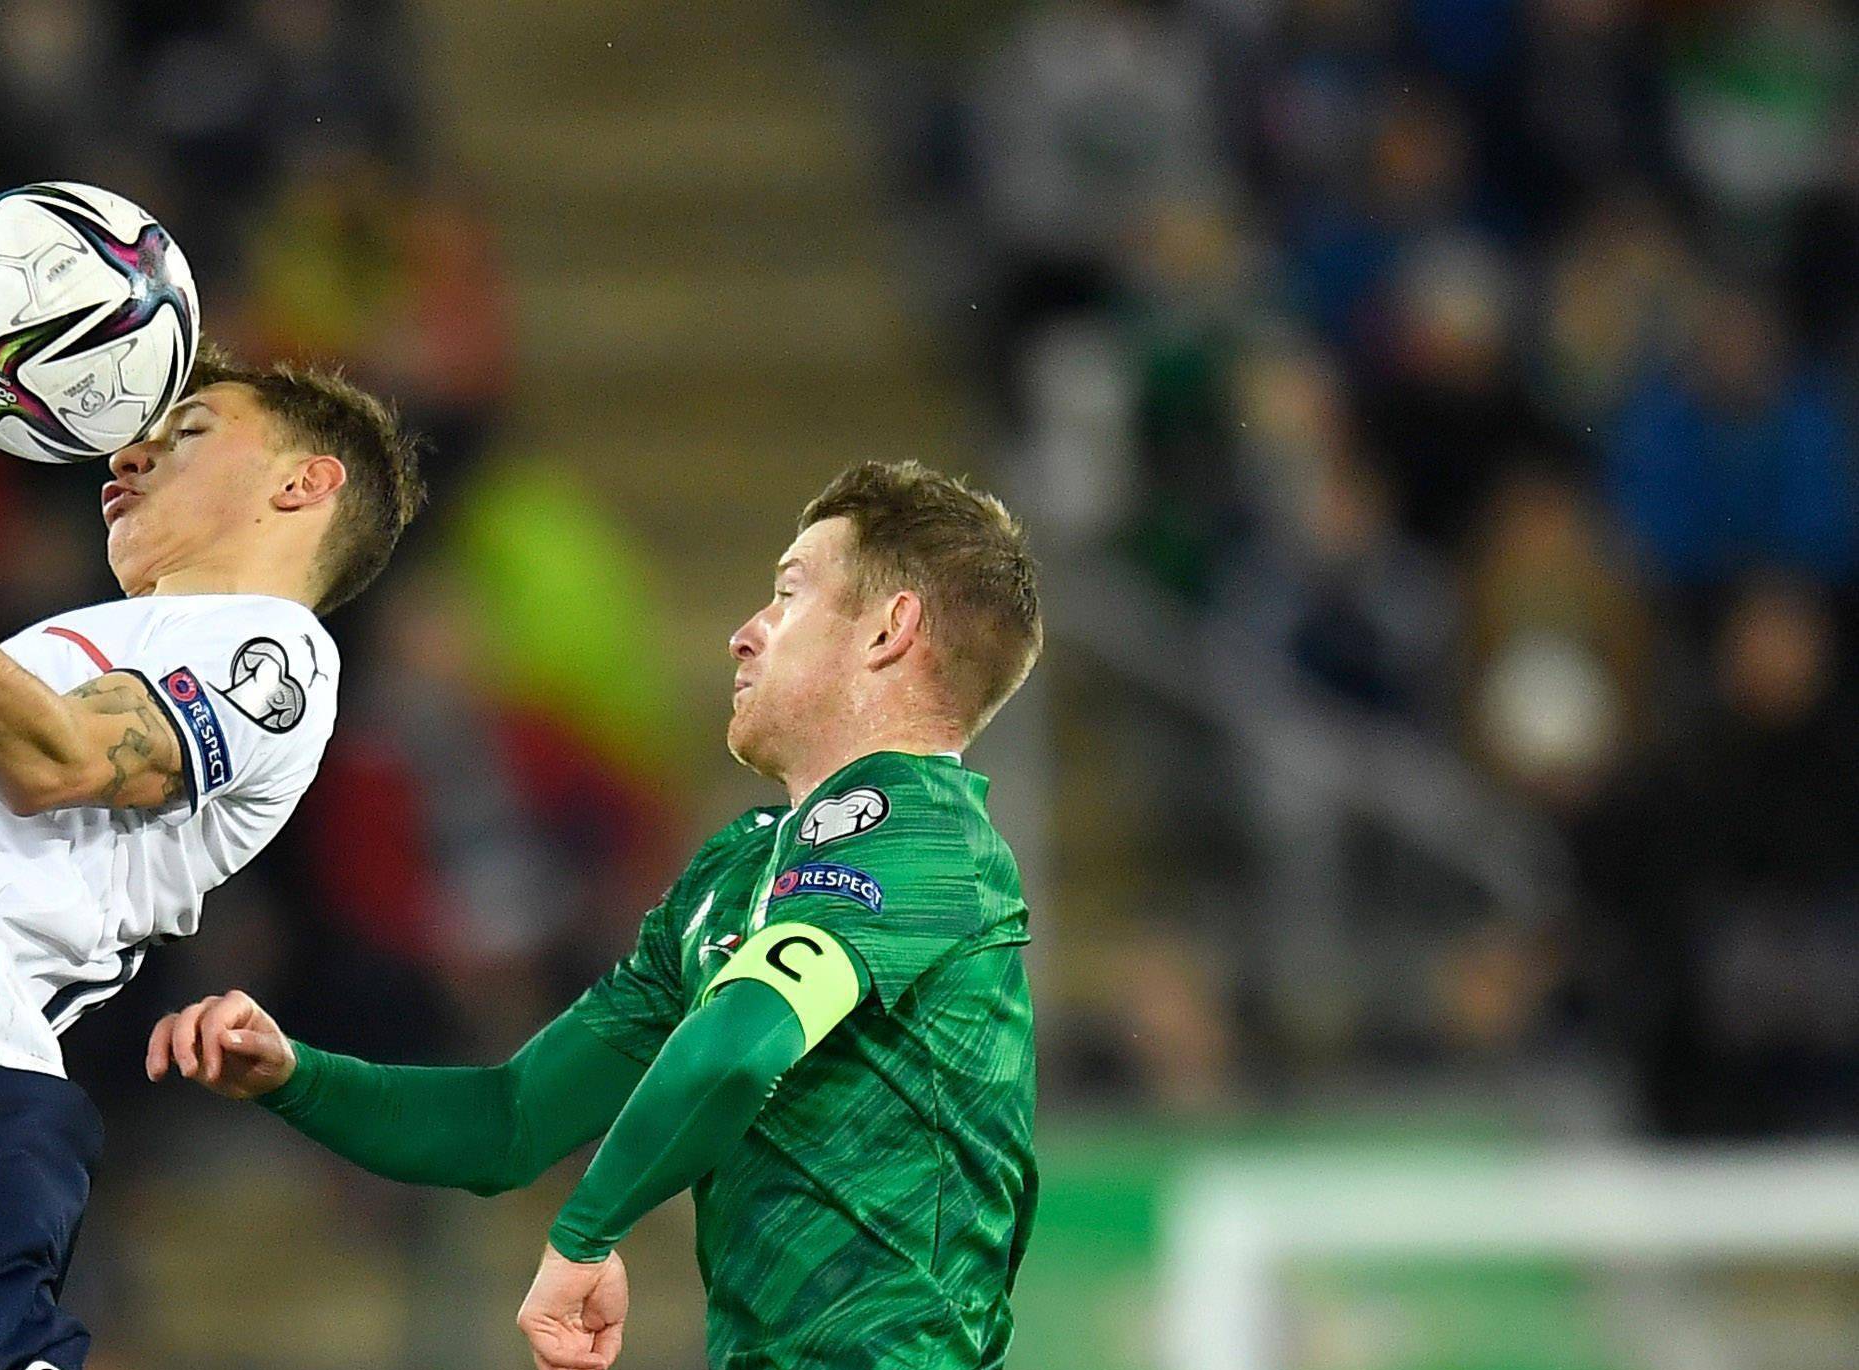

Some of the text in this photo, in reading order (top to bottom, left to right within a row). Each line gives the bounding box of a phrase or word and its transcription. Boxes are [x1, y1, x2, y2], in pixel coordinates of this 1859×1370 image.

[188, 701, 225, 785] RESPECT
[800, 870, 883, 905] RESPECT
[766, 936, 824, 983] C
